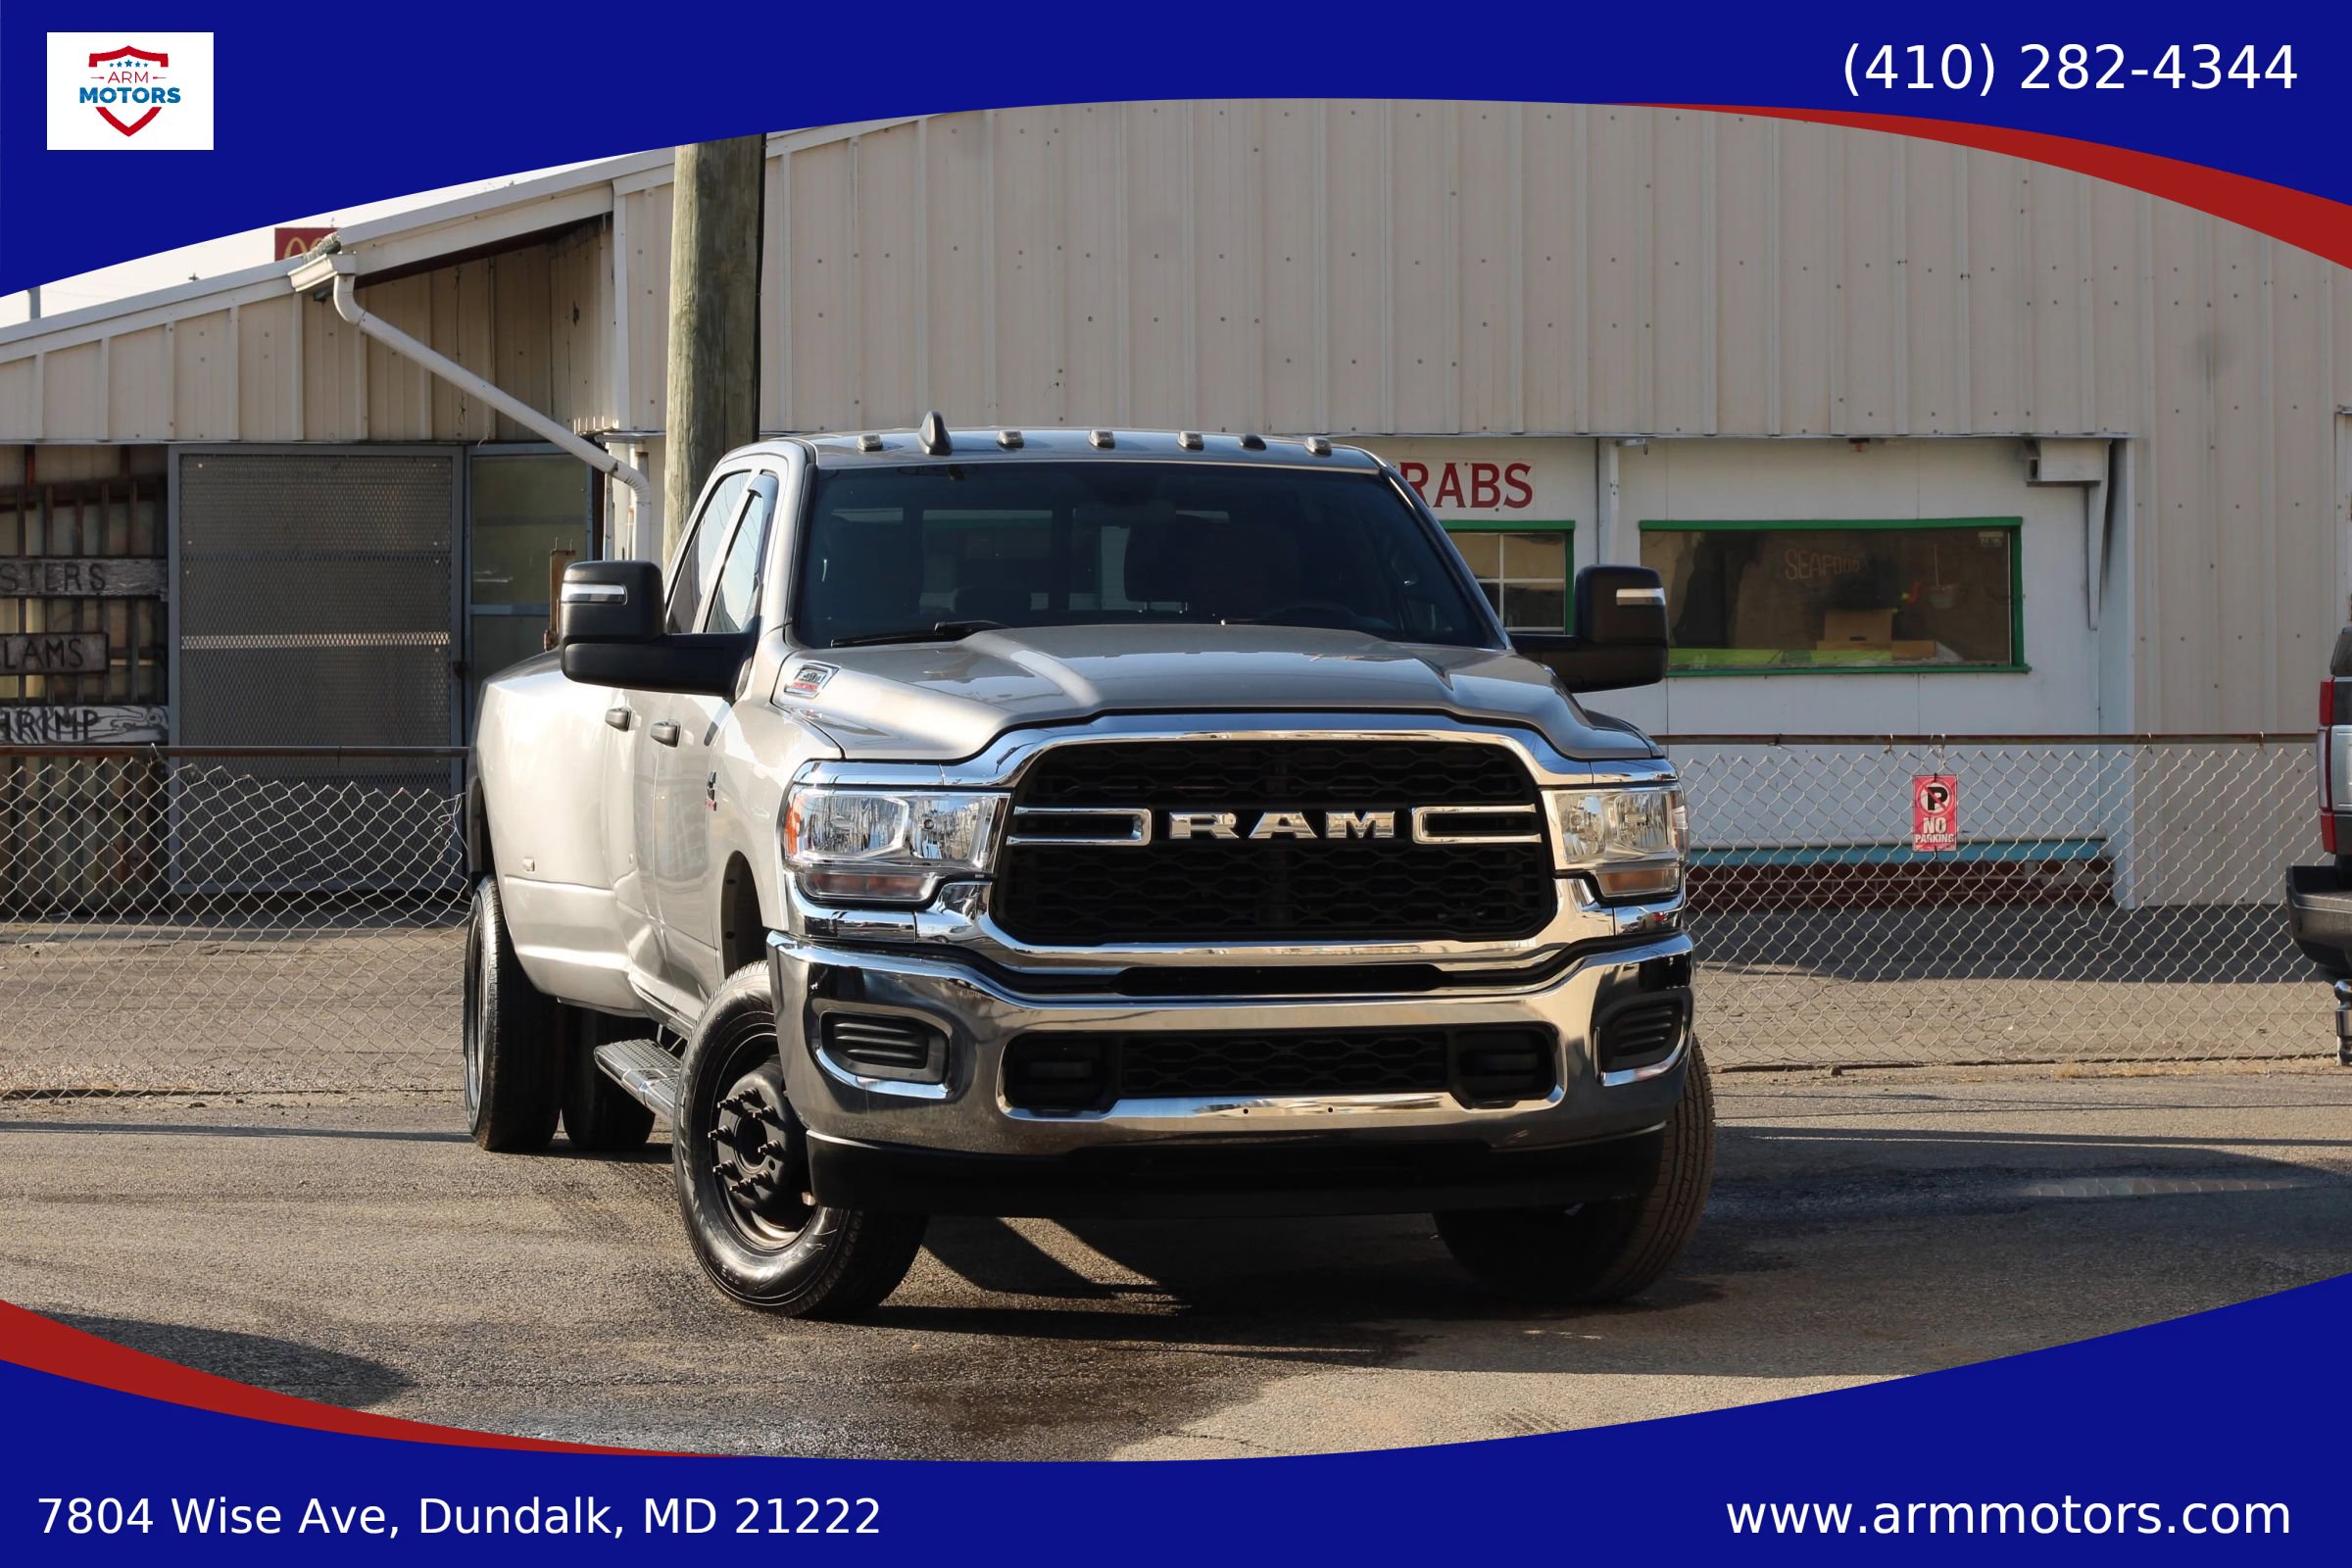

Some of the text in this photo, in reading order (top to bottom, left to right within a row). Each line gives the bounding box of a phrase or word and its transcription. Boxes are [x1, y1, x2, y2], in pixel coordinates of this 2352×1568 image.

[1396, 462, 1534, 510] RABS
[0, 562, 107, 593] STERS
[0, 637, 84, 669] LAMS
[1168, 810, 1396, 840] RAM
[1915, 833, 1955, 844] PARKING
[1923, 817, 1947, 834] NO
